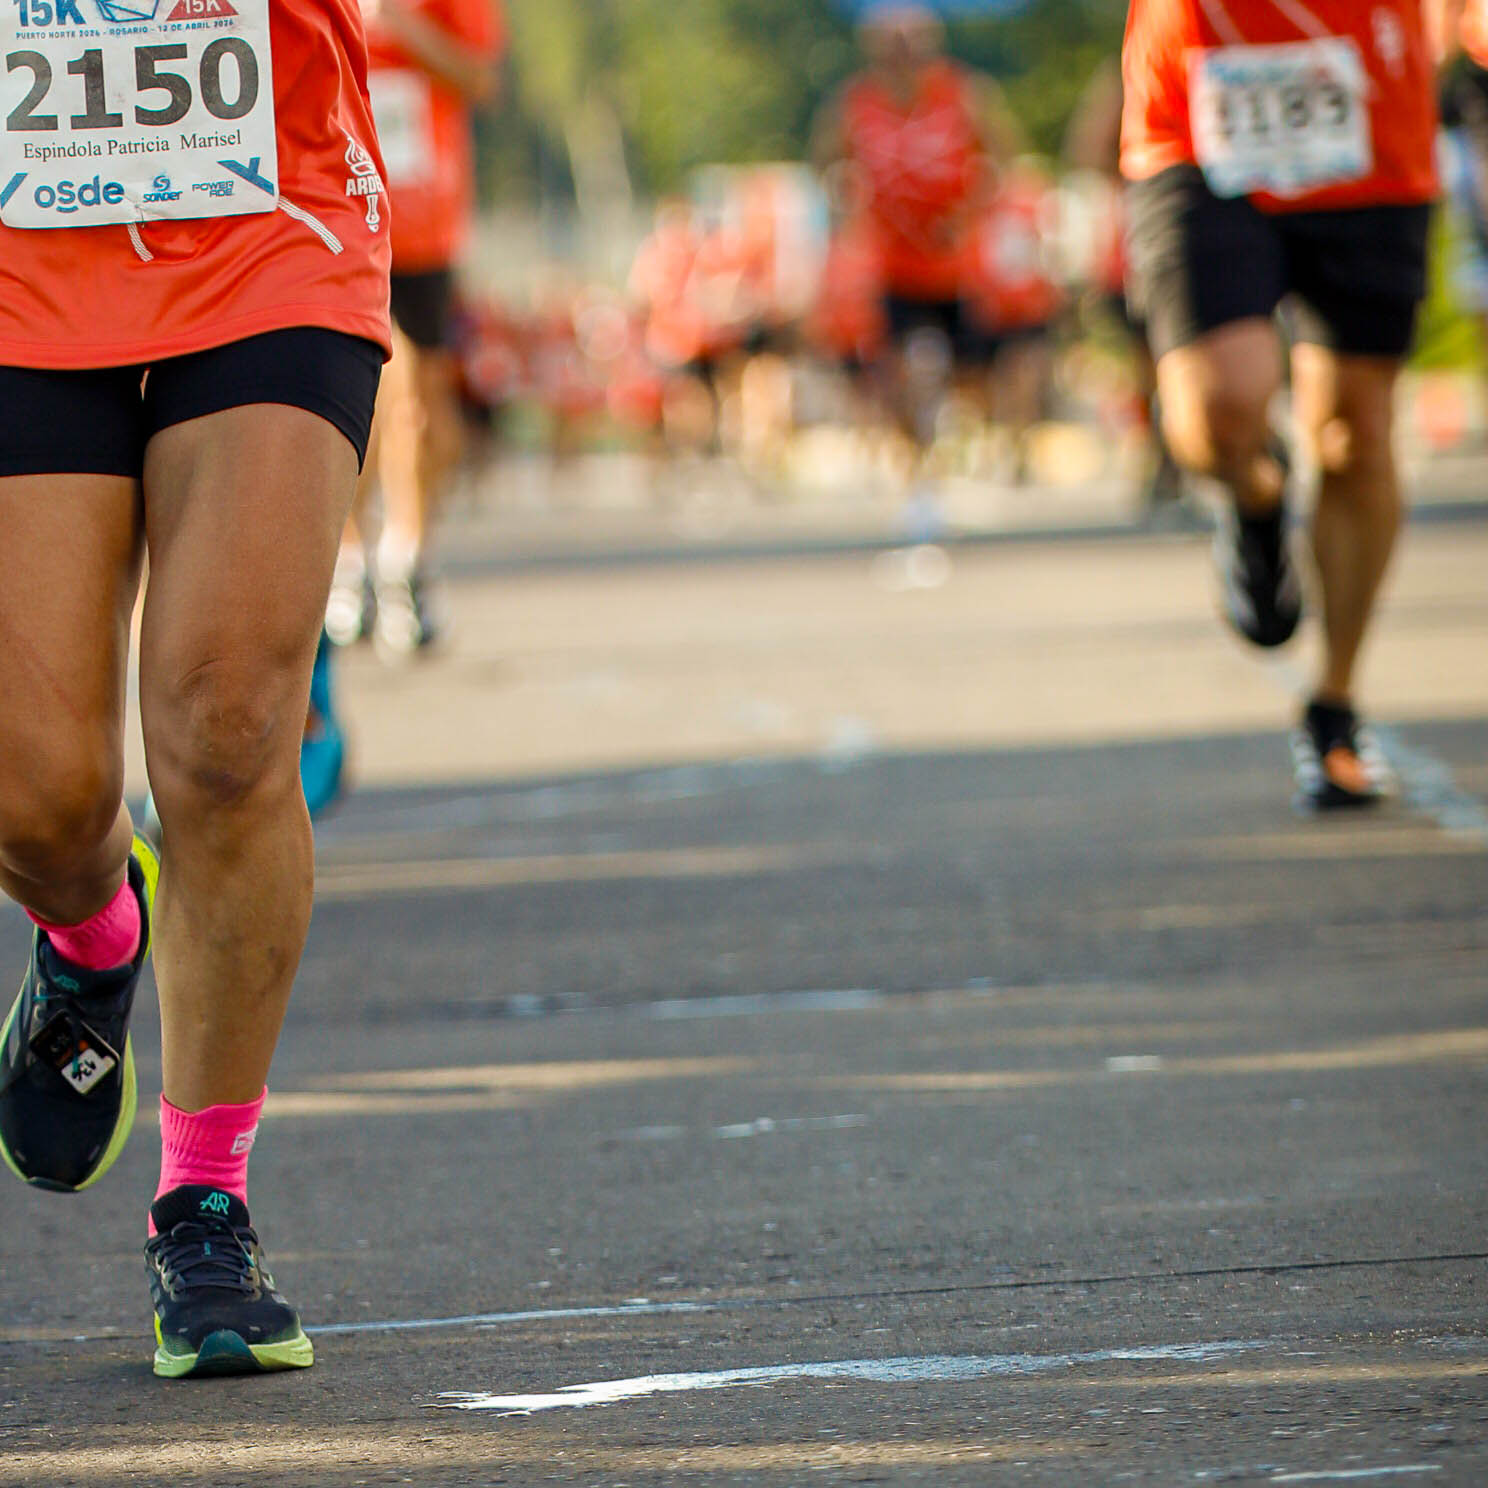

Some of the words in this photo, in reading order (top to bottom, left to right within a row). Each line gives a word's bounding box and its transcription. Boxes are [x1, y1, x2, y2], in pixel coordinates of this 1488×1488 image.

[16, 31, 46, 40] PUERTO
[49, 30, 75, 39] NORTE
[110, 25, 148, 35] ROSARIO
[172, 23, 182, 31] DE
[185, 20, 211, 30] ABRIL
[6, 36, 259, 131] 2150
[24, 142, 102, 162] Espindola
[107, 136, 170, 156] Patricia
[180, 129, 242, 150] Marisel
[34, 174, 125, 213] osde
[192, 180, 234, 192] POWER
